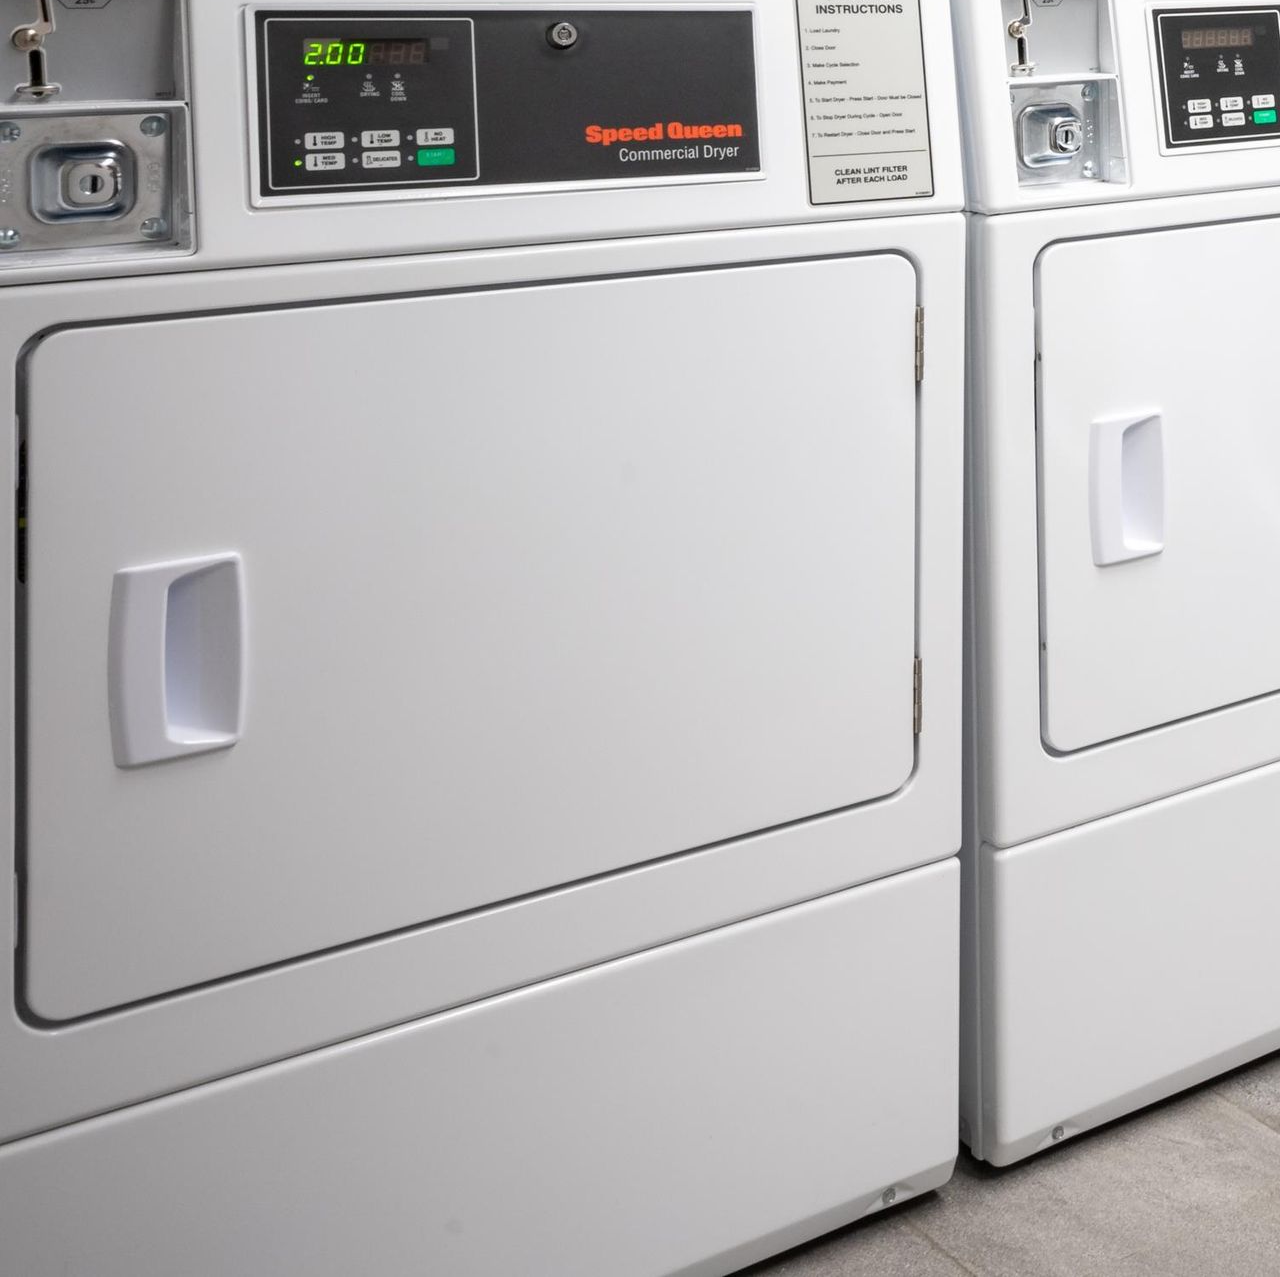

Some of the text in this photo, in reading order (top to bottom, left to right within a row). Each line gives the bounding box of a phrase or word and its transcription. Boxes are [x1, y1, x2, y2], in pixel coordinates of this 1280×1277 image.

[816, 4, 903, 14] INSTRUCTIONS
[303, 43, 366, 65] 2.00
[585, 122, 743, 146] Speed Queen
[619, 145, 739, 162] Commercial Dryer
[835, 165, 908, 176] CLEAN LINT FILTER
[837, 174, 908, 185] AFTER EACH LOAD
